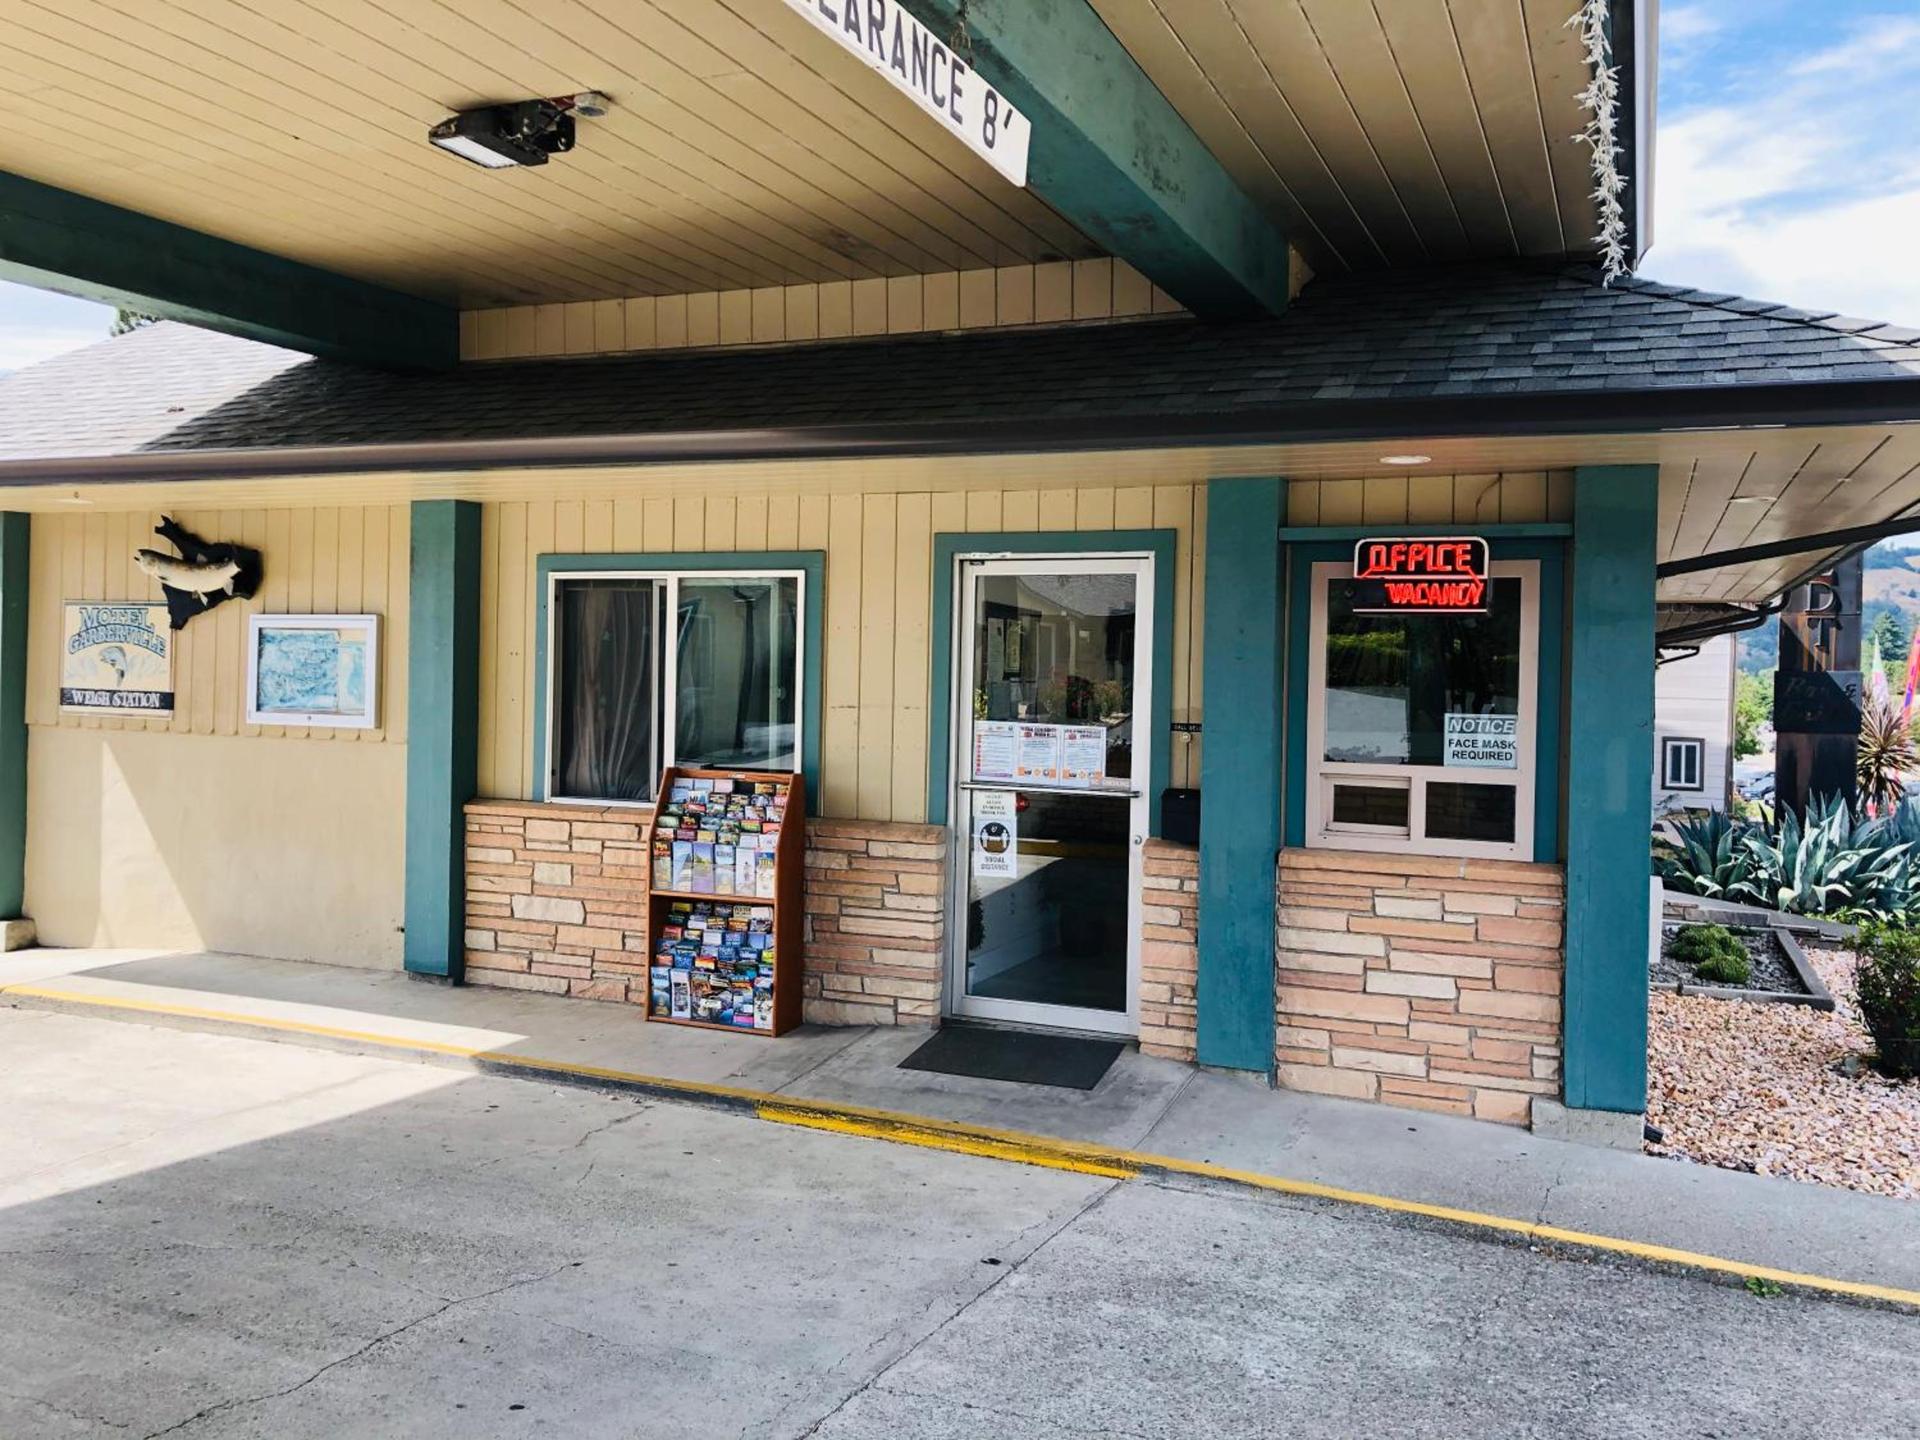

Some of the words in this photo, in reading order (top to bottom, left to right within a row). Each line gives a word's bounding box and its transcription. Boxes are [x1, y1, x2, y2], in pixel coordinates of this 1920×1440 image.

[982, 88, 1013, 149] 8'
[1369, 543, 1471, 572] OFFICE
[1384, 582, 1484, 606] VACANCY
[79, 607, 155, 634] MOTEL
[68, 624, 166, 658] GARBERVILLE
[72, 690, 110, 706] WEIGH
[112, 692, 161, 708] STATION
[1449, 718, 1516, 733] NOTICE
[1448, 738, 1479, 749] FACE
[1482, 740, 1516, 750] MASK
[1452, 750, 1513, 761] REQUIRED
